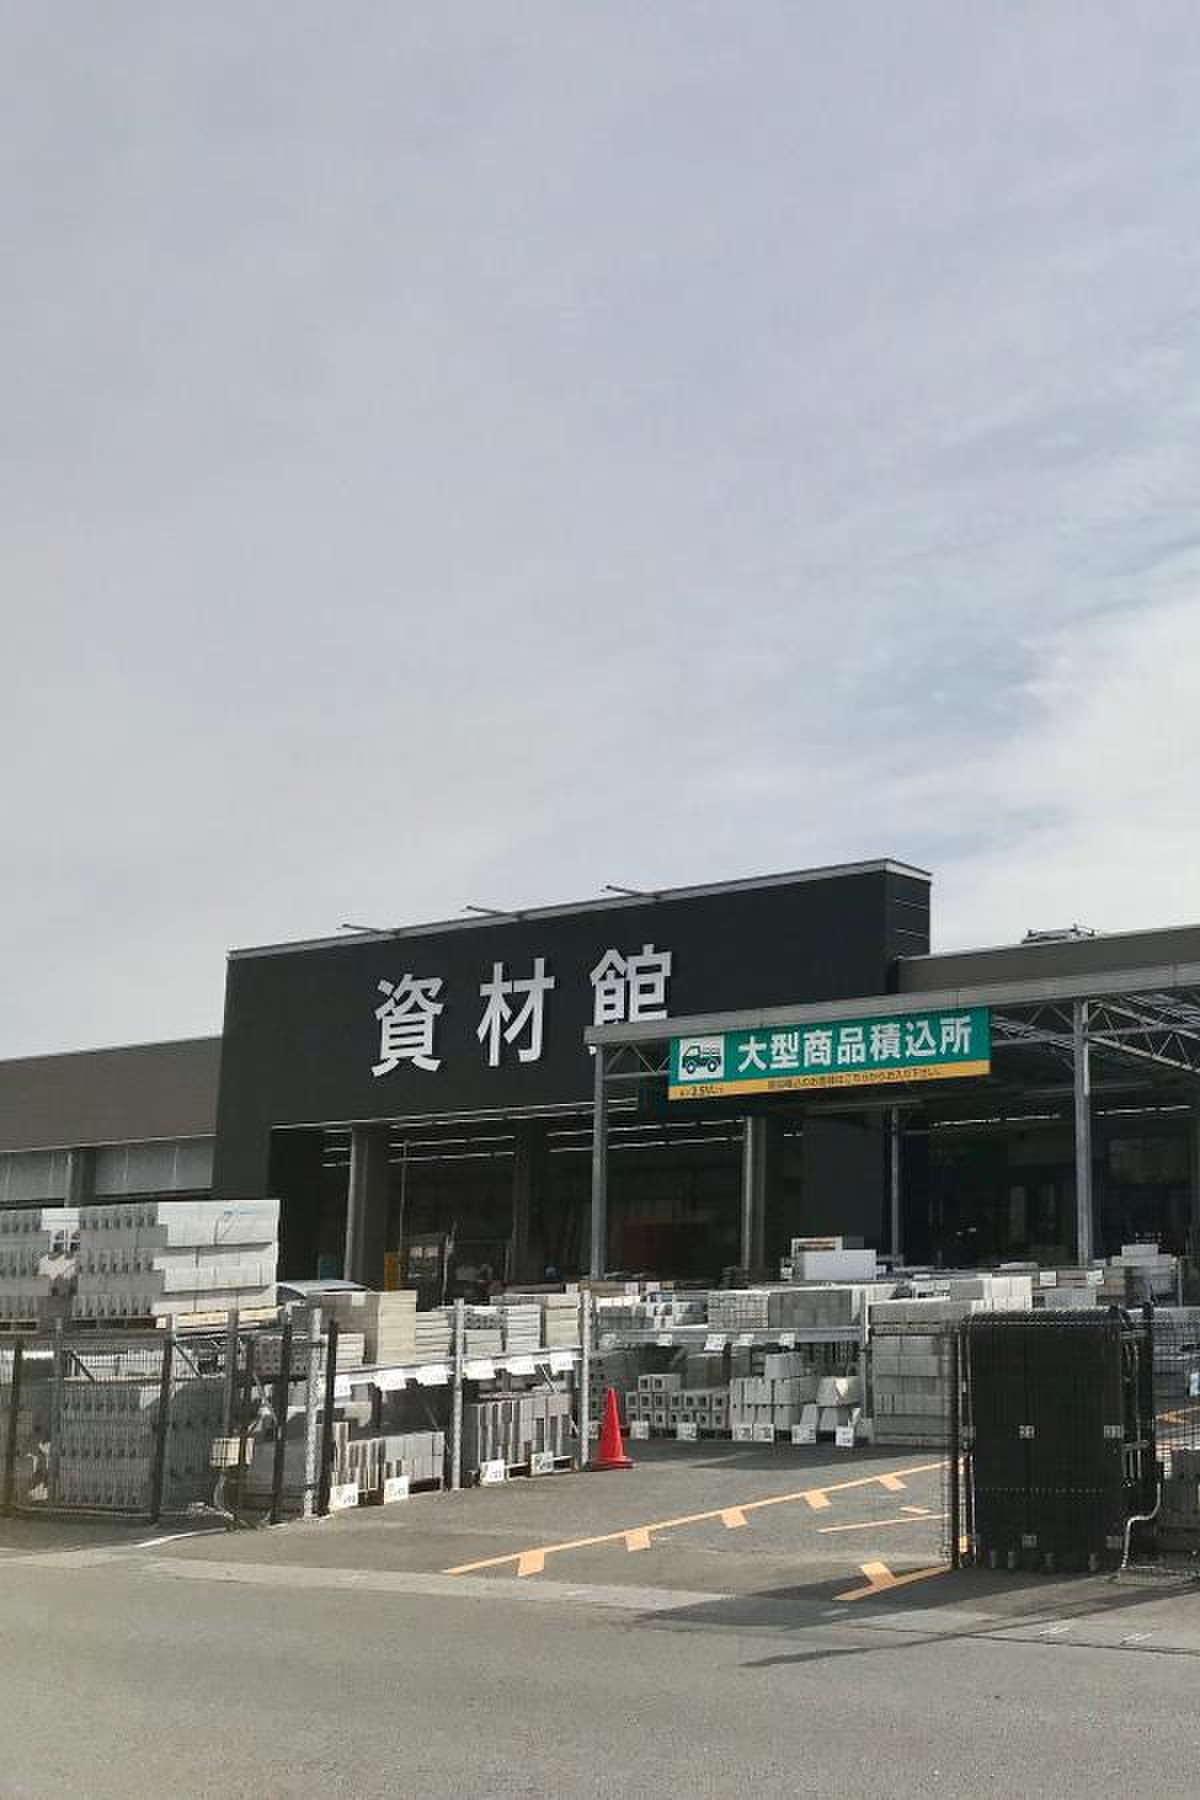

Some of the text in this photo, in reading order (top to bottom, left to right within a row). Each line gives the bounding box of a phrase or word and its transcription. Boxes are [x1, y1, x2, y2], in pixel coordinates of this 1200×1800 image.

[371, 944, 672, 1077] 資材館
[737, 1016, 971, 1073] 大型商品積込所
